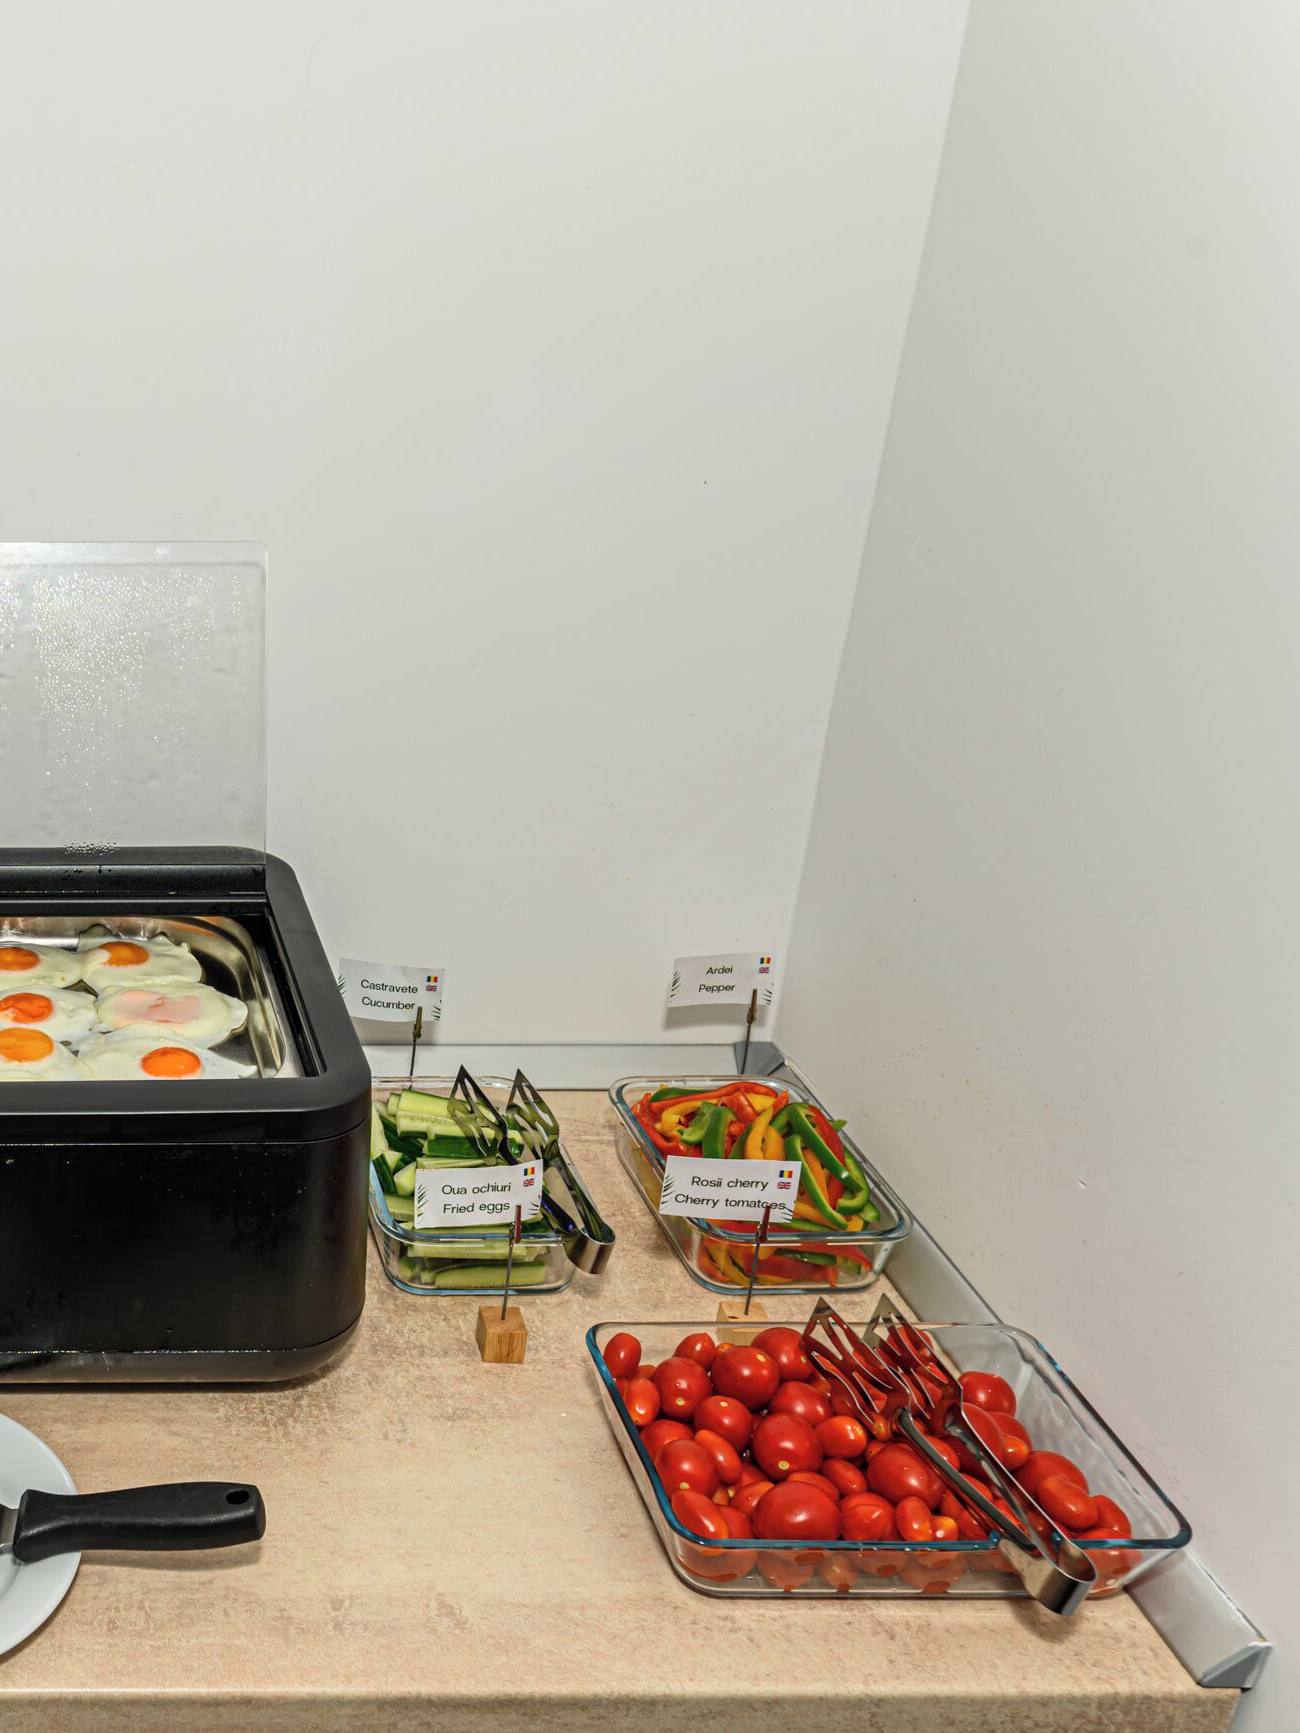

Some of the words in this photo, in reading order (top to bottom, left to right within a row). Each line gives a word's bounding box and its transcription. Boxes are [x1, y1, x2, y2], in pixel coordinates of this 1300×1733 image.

[705, 965, 734, 975] Ardei
[360, 979, 419, 994] Castravete
[698, 984, 736, 994] Pepper
[361, 996, 416, 1010] Cucumber
[441, 1184, 467, 1195] Oua
[471, 1182, 511, 1195] ochiuri
[691, 1176, 723, 1188] Rosii
[726, 1178, 769, 1191] cherry
[674, 1193, 720, 1209] Cherry
[443, 1203, 475, 1214] Fried
[479, 1202, 510, 1214] eggs
